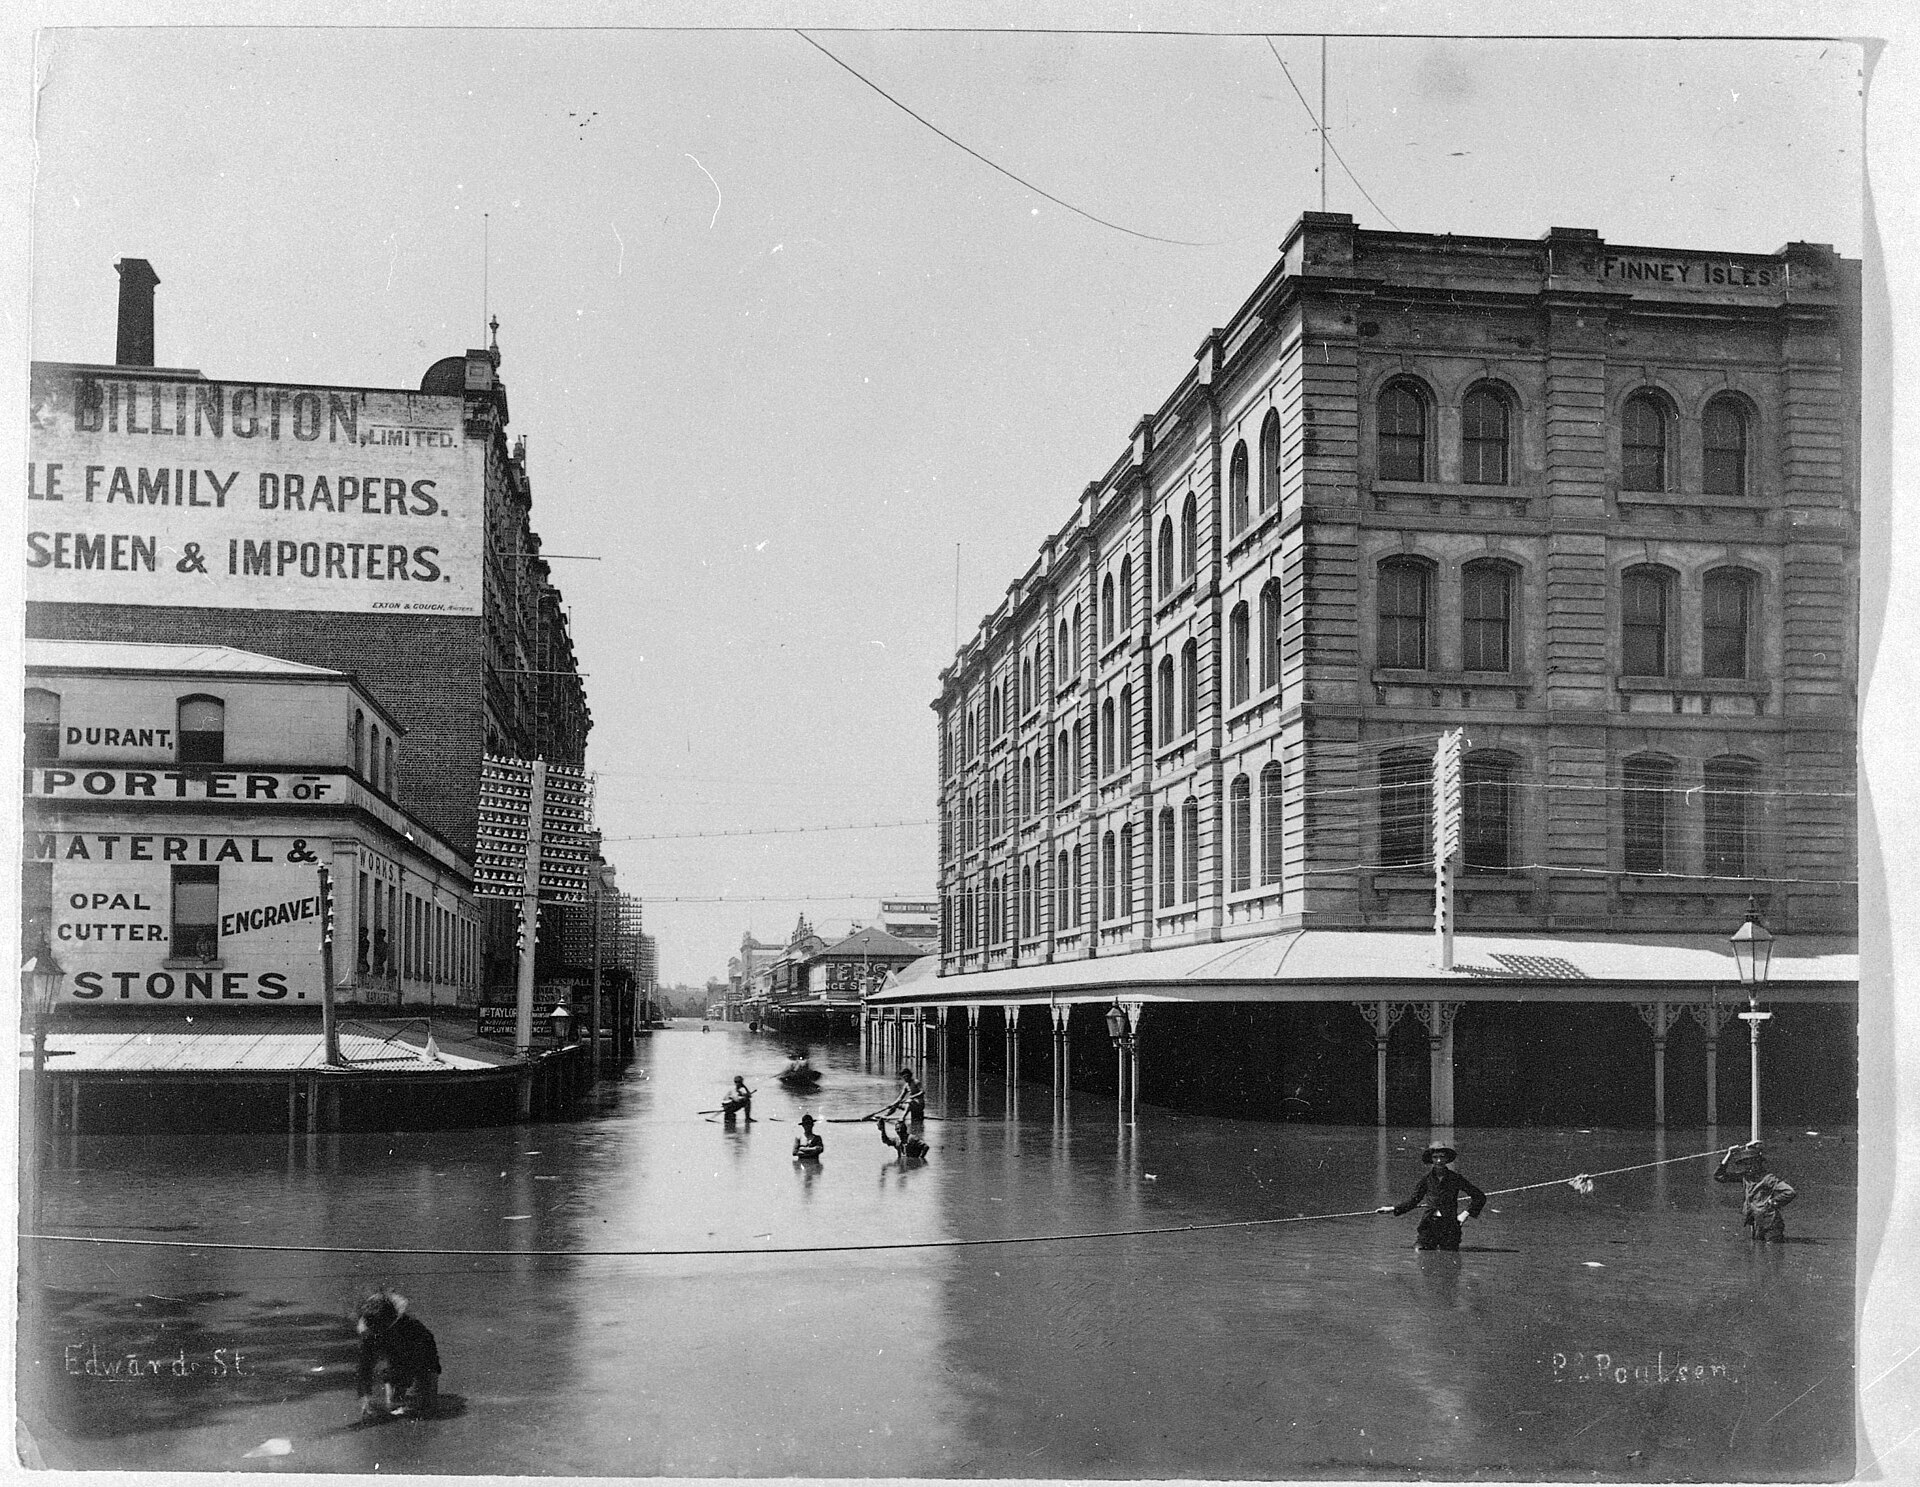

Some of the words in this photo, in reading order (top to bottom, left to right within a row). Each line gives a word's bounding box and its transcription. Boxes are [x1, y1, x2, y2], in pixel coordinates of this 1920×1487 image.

[1603, 256, 1690, 283] FINNEY
[1704, 262, 1771, 286] ISLES
[86, 465, 240, 508] FAMILY
[259, 473, 448, 517] DRAPERS.
[27, 532, 156, 572] SEMEN
[176, 542, 208, 574] &
[229, 539, 451, 583] IMPORTERS.
[66, 727, 174, 750] DURANT,
[292, 784, 331, 800] OF
[28, 834, 274, 863] MATERIAL
[287, 838, 318, 863] &
[69, 893, 150, 910] OPAL
[57, 924, 168, 941] CUTTER.
[72, 972, 305, 1000] STONES.
